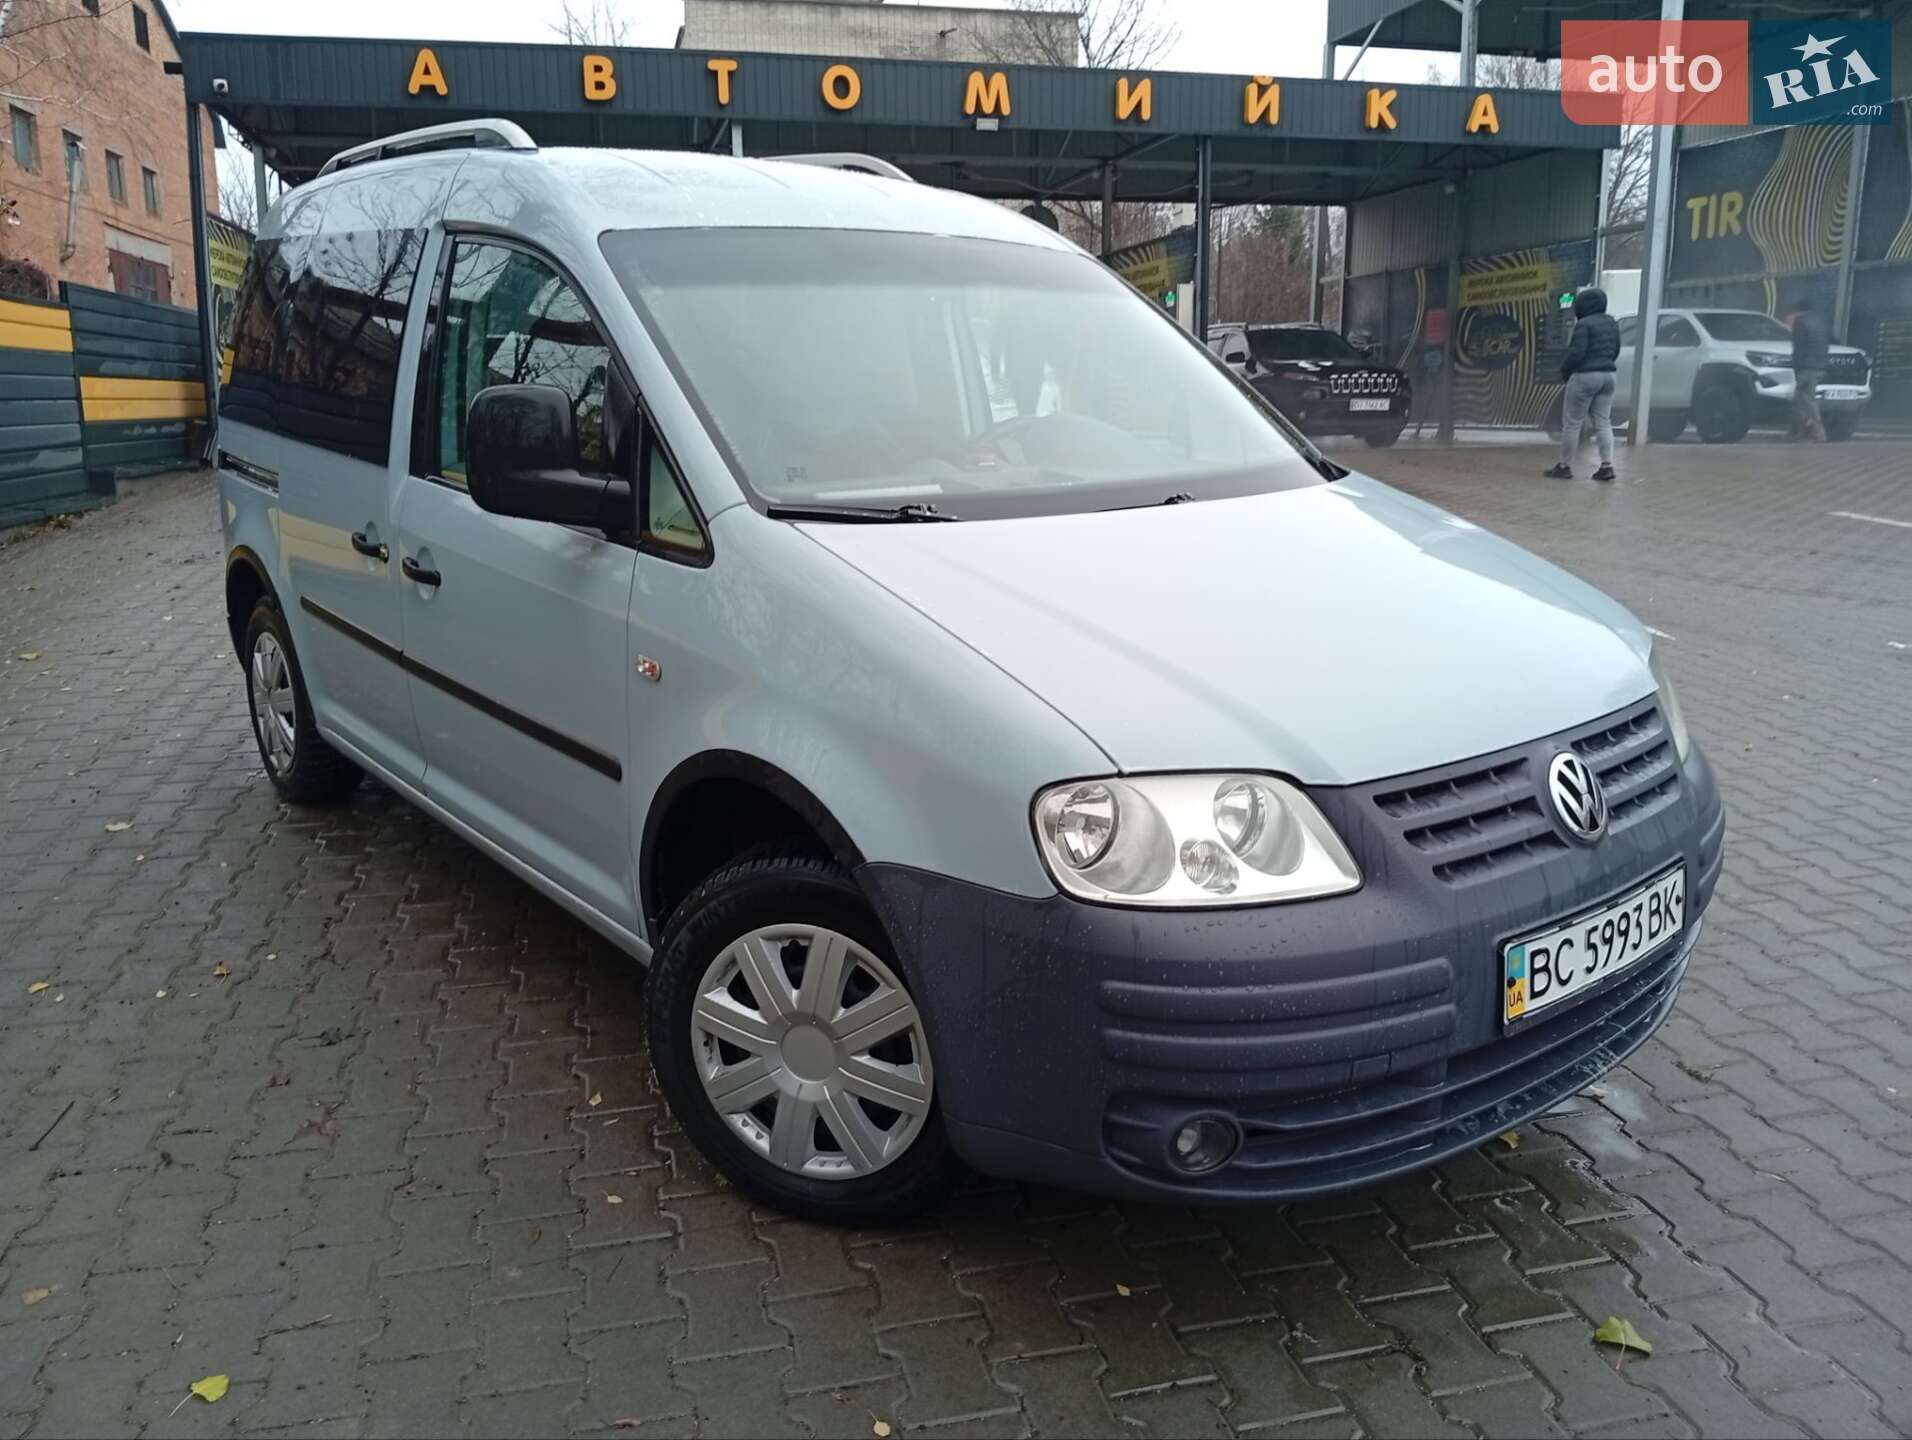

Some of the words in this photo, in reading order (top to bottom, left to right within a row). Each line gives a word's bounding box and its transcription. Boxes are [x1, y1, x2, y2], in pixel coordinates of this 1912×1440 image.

[408, 48, 1500, 134] АВТОМИЙКА
[1686, 190, 1744, 243] TIR
[1529, 937, 1574, 1001] BC
[1584, 902, 1643, 975] 5993
[1648, 879, 1678, 941] BK
[1508, 990, 1523, 1008] UA
